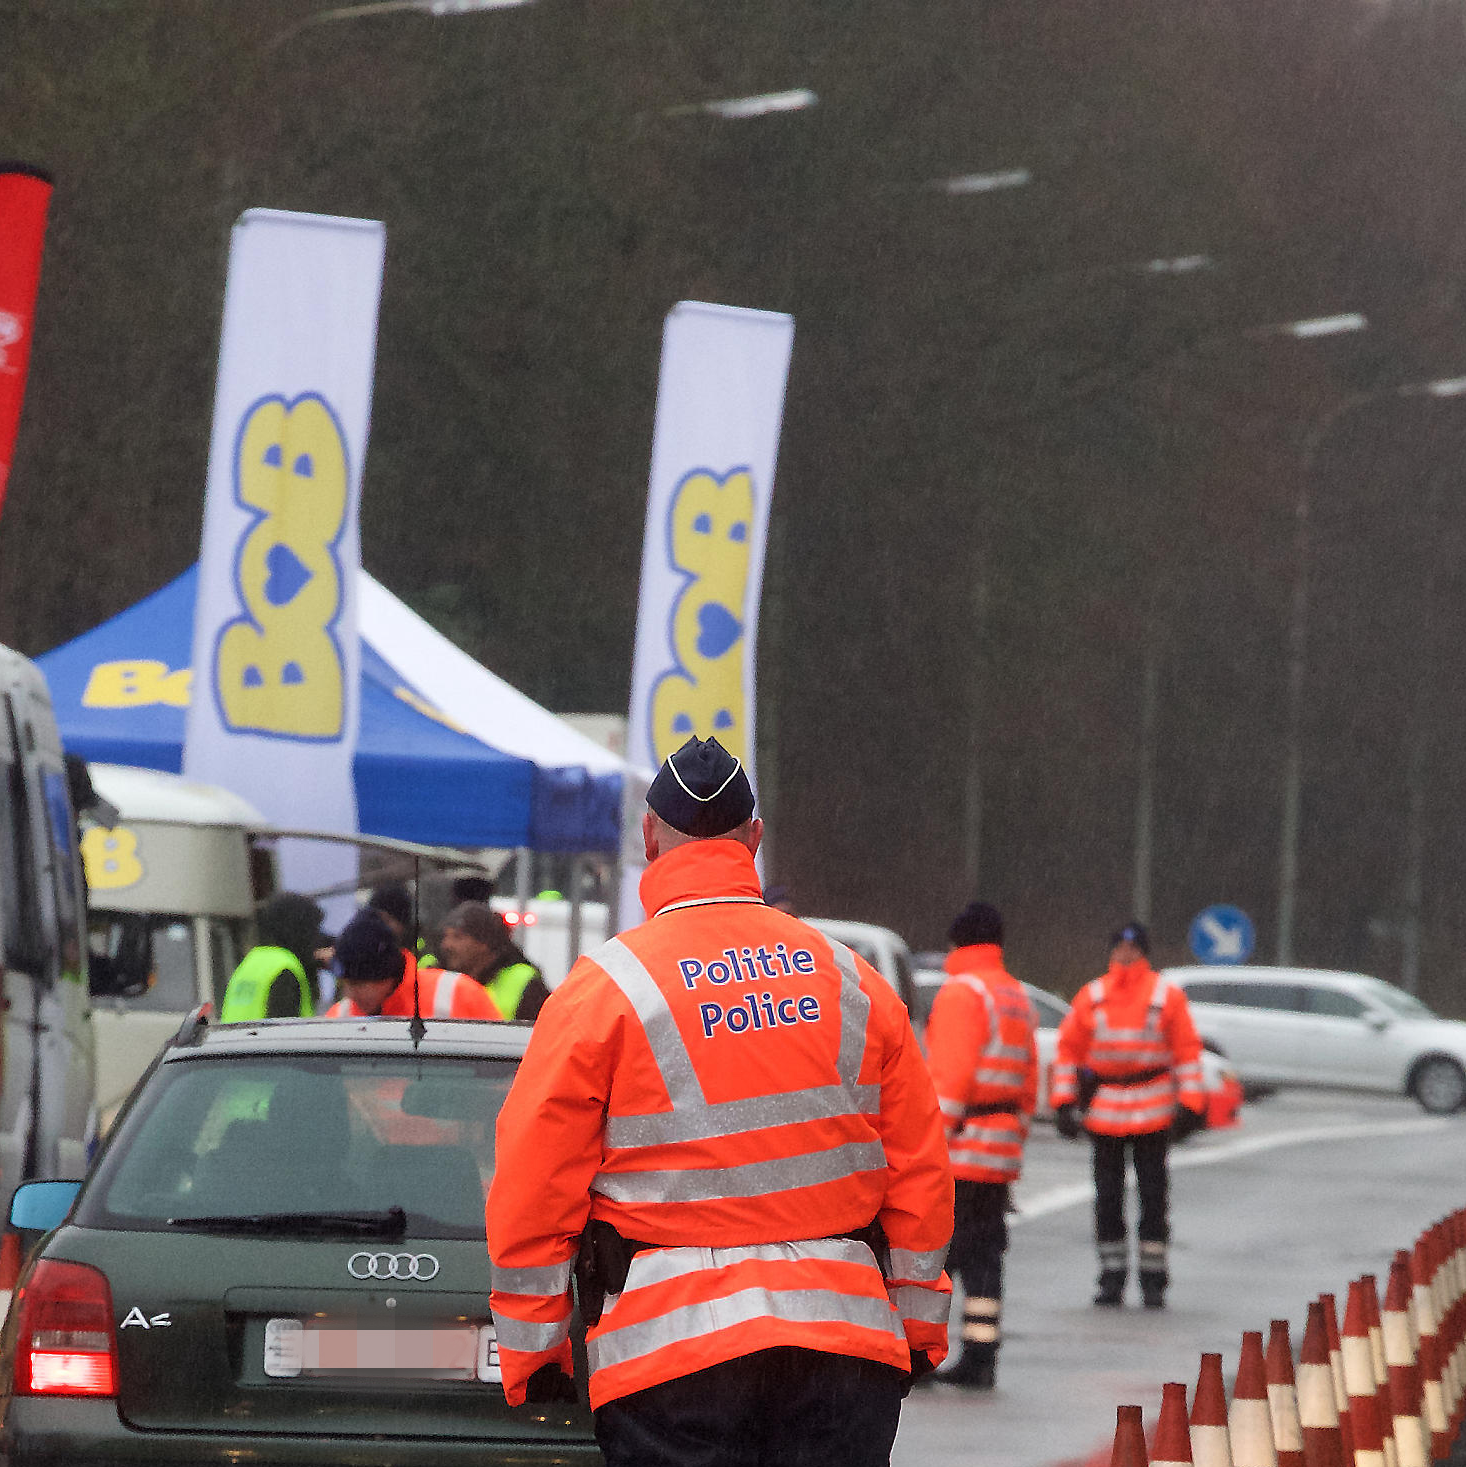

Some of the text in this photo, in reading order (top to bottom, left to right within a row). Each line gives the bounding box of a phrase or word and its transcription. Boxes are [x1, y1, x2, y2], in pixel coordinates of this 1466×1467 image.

[213, 391, 350, 743] BOB
[678, 942, 816, 990] Politie
[700, 992, 820, 1039] Police
